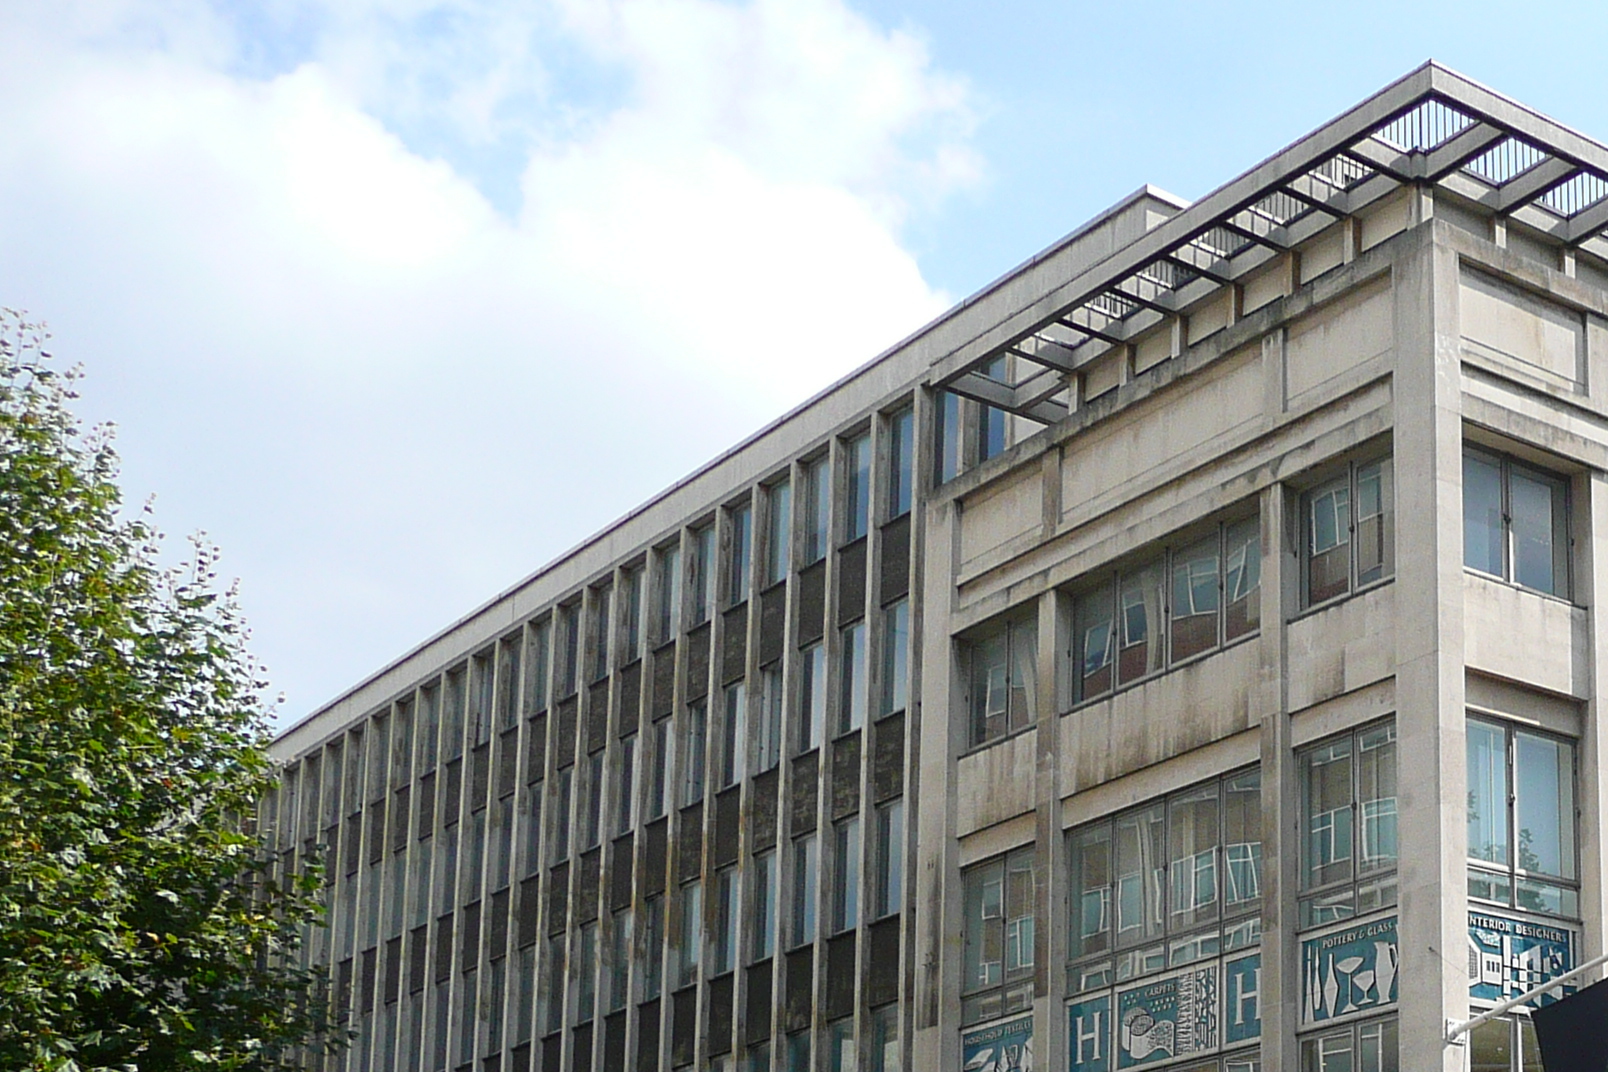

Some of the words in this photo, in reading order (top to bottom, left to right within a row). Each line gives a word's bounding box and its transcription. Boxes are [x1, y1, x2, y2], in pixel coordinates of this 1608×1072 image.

[1322, 931, 1357, 949] POTTERY
[1367, 921, 1393, 937] GLASS
[1469, 915, 1511, 932] NTERIOR
[1516, 924, 1567, 942] DESIGNERS
[1144, 981, 1176, 998] CARPETS
[1233, 967, 1261, 1026] H
[1076, 1011, 1101, 1064] H
